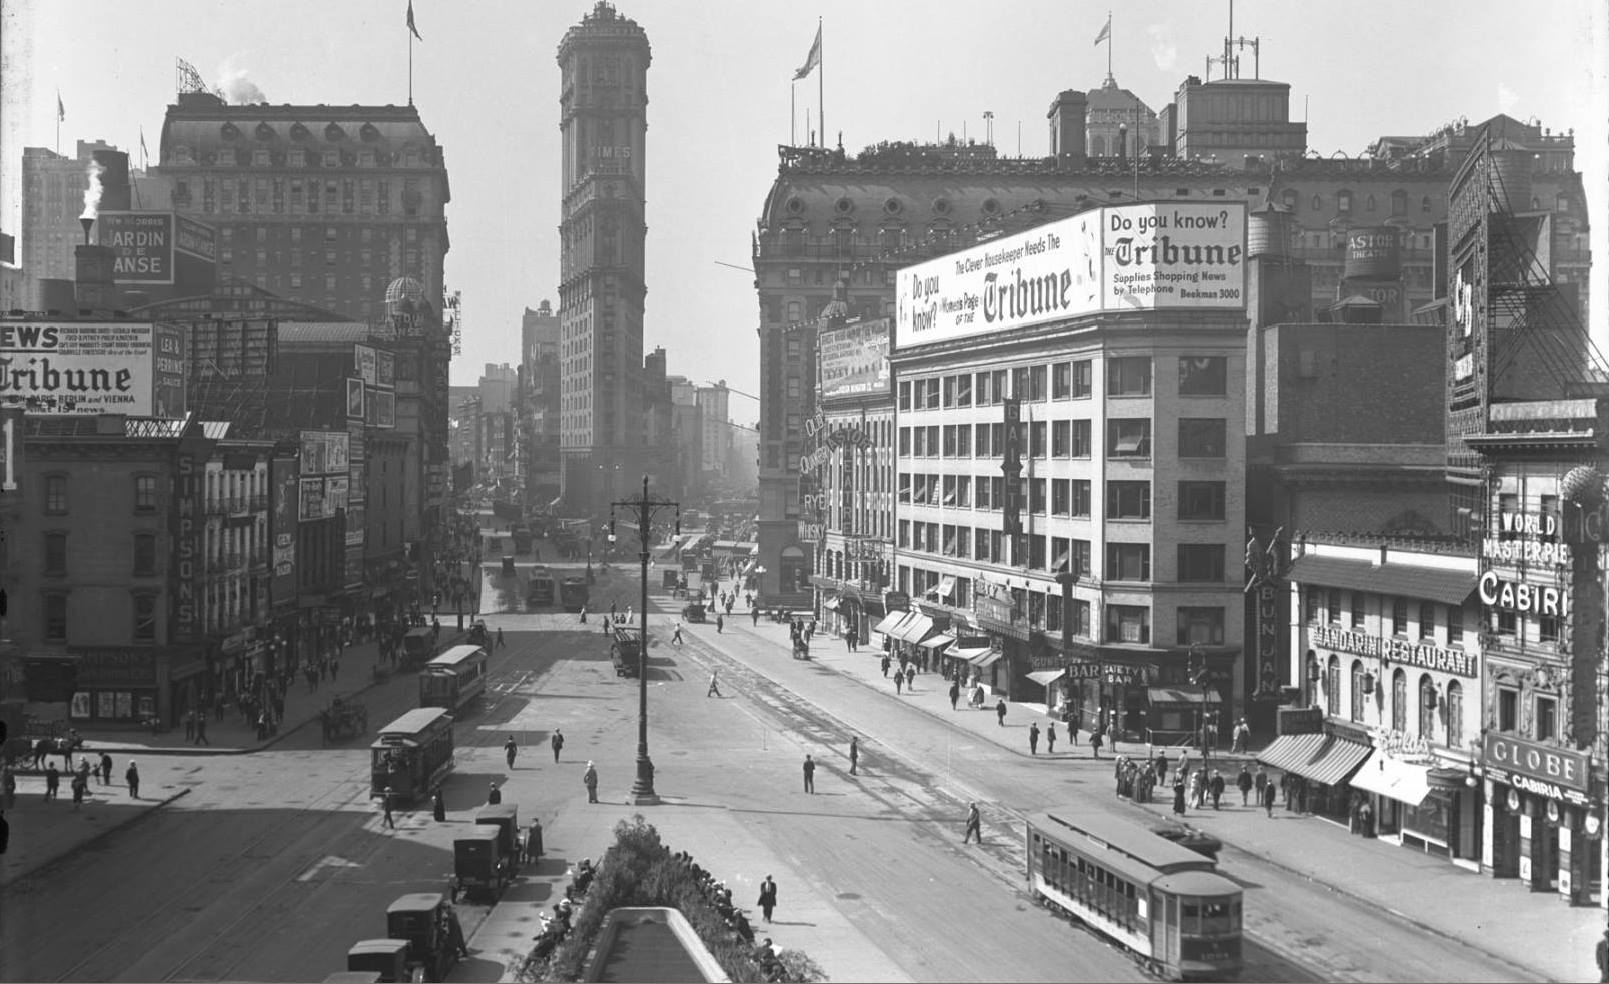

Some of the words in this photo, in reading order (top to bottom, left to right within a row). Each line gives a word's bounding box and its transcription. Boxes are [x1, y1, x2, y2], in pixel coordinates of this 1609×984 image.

[1111, 214, 1133, 231] Do
[1139, 215, 1167, 234] you
[1174, 210, 1228, 229] know?
[1115, 235, 1241, 267] Tribune
[1348, 233, 1394, 249] ASTOR
[113, 257, 162, 273] ANSE
[955, 260, 965, 276] The
[965, 257, 983, 273] Clever
[984, 245, 1024, 269] Housekeeper
[1024, 238, 1046, 257] Needs
[1047, 233, 1061, 251] The
[912, 273, 922, 300] Do
[924, 274, 939, 302] you
[1113, 272, 1151, 285] Supplies
[1153, 271, 1199, 284] Shopping
[1201, 271, 1227, 281] News
[983, 267, 1072, 323] Tribune
[1113, 284, 1124, 296] by
[1128, 284, 1174, 296] Telephone
[1180, 288, 1218, 299] Beekman
[1219, 287, 1240, 299] 3000
[912, 301, 937, 333] know?
[103, 394, 136, 404] VIENNA
[1008, 403, 1019, 529] GAIETY
[1503, 511, 1556, 536] WORLD
[179, 456, 193, 622] SIMPSONS
[1314, 626, 1380, 657] MANDARIN
[1382, 638, 1476, 676] RESTAURANT
[1069, 664, 1100, 678] BAR
[1108, 675, 1132, 684] BAR
[1493, 740, 1575, 780] GLOBE
[1512, 774, 1563, 800] CABIRIA
